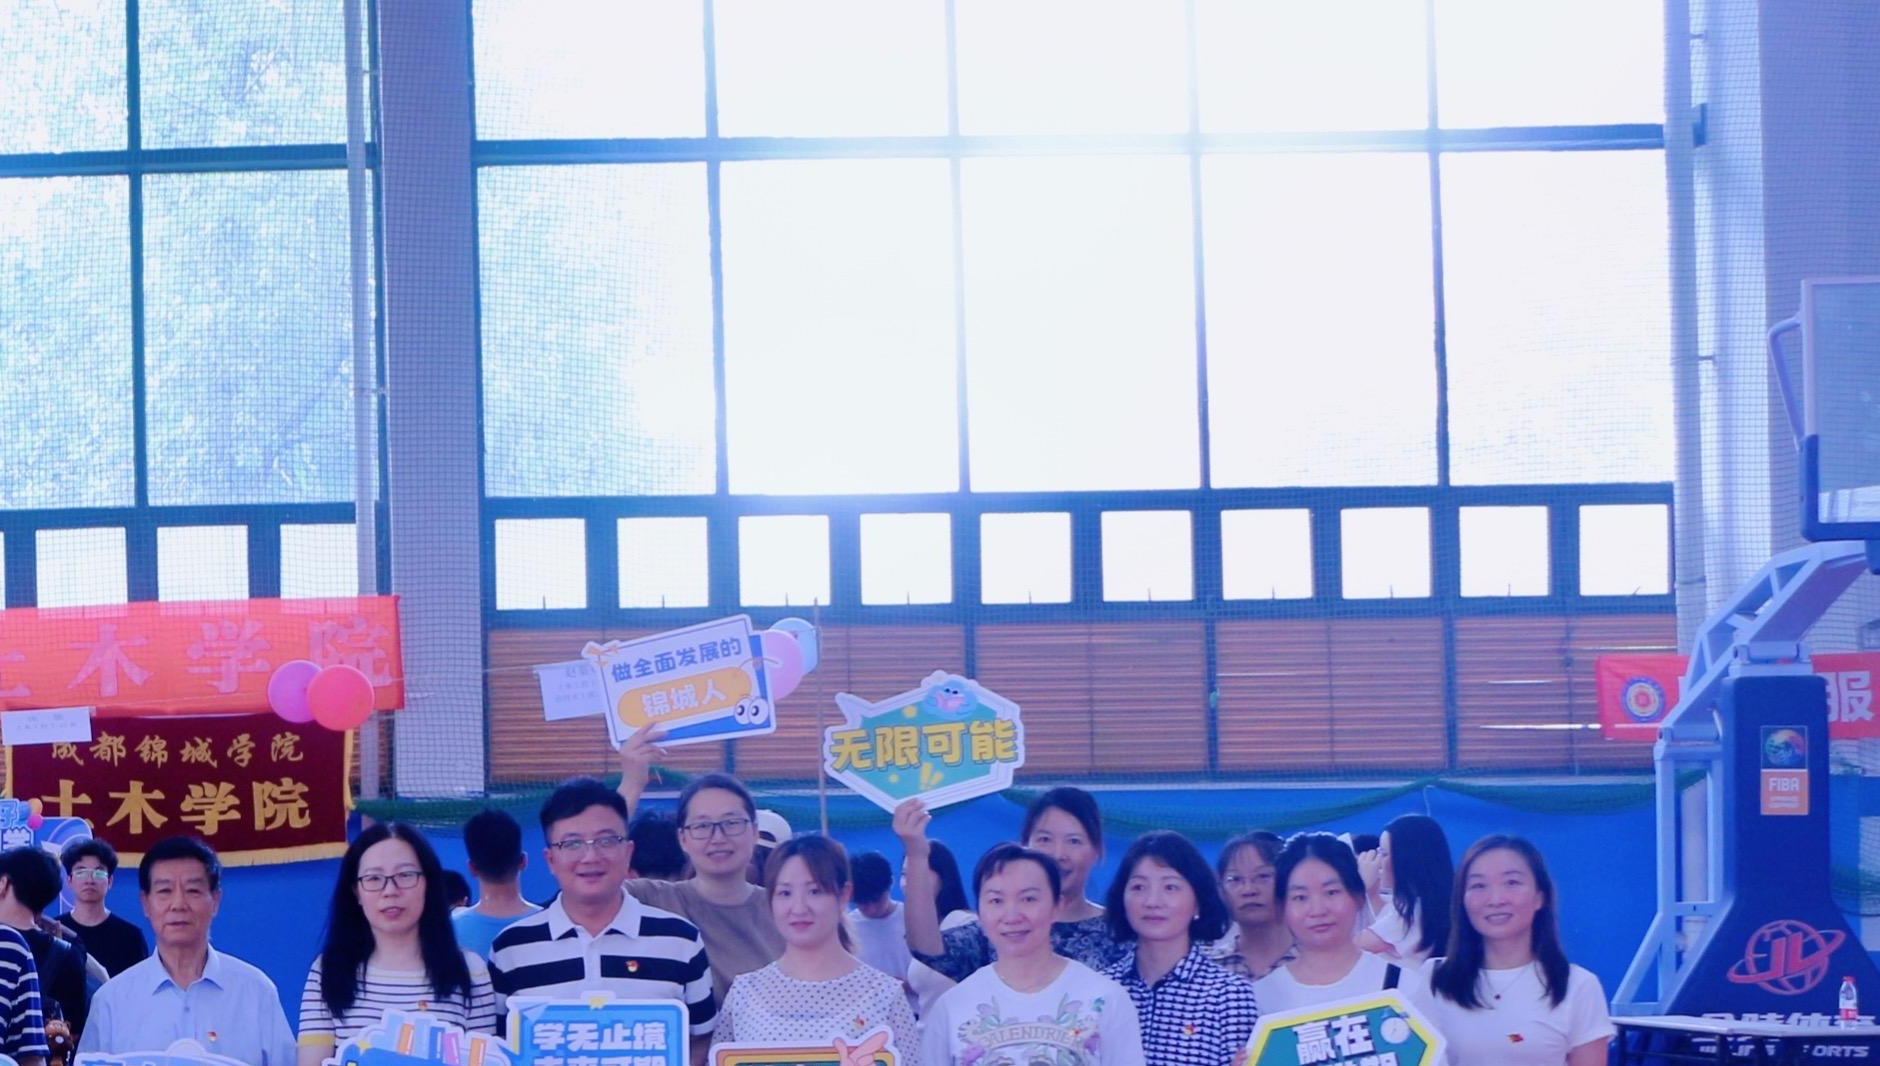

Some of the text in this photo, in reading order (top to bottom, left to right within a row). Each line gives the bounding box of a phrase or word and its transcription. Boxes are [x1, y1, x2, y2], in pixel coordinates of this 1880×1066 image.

[612, 637, 742, 682] 做全面发展的
[641, 678, 727, 717] 锦城人
[52, 731, 304, 768] 成都锦城学院
[830, 718, 1017, 771] 无限可能
[1768, 777, 1800, 792] FIBA
[41, 777, 311, 836] 土木学院
[533, 1021, 667, 1051] 学无止境
[1292, 1015, 1376, 1066] 赢在
